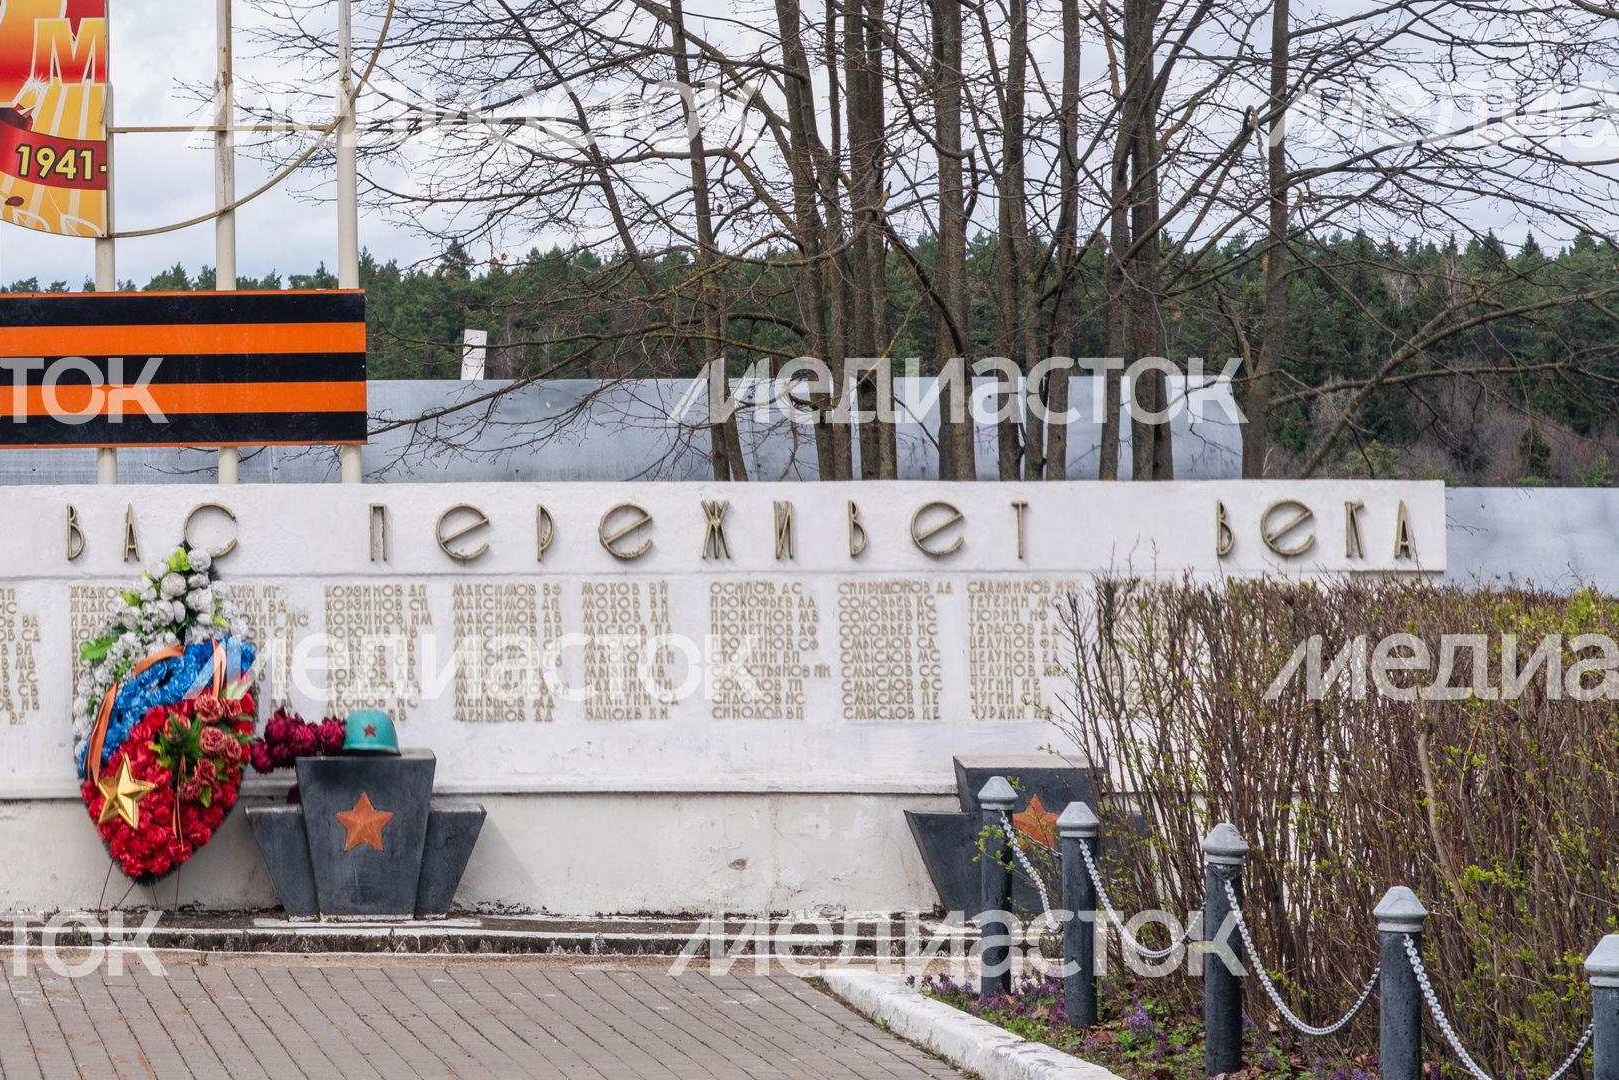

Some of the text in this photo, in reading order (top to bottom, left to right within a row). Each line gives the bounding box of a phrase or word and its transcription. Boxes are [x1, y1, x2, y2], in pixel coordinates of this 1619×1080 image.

[66, 502, 238, 562] ВАС
[453, 584, 536, 597] МАКСИМОВ
[582, 583, 640, 596] МОХОВ
[454, 598, 536, 610] МАКСИМОВ
[583, 597, 640, 610] МОХОВ
[711, 596, 792, 608] ПРОКОФЬЕВ
[838, 596, 912, 610] СОЛОВЬЕВ
[454, 611, 537, 624] МАКСИМОВ
[583, 611, 641, 624] МОХОВ
[839, 609, 913, 623] СОЛОВЬЕВ
[839, 623, 913, 637] СОЛОВЬЕВ
[840, 636, 911, 651] СМЫСЛОВ
[840, 650, 912, 664] СМЫСЛОВ
[841, 664, 912, 678] СМЫСЛОВ
[841, 678, 913, 692] СМЫСЛОВ
[842, 692, 914, 705] СМЫСЛОВ
[843, 705, 915, 720] СМЫСЛОВ
